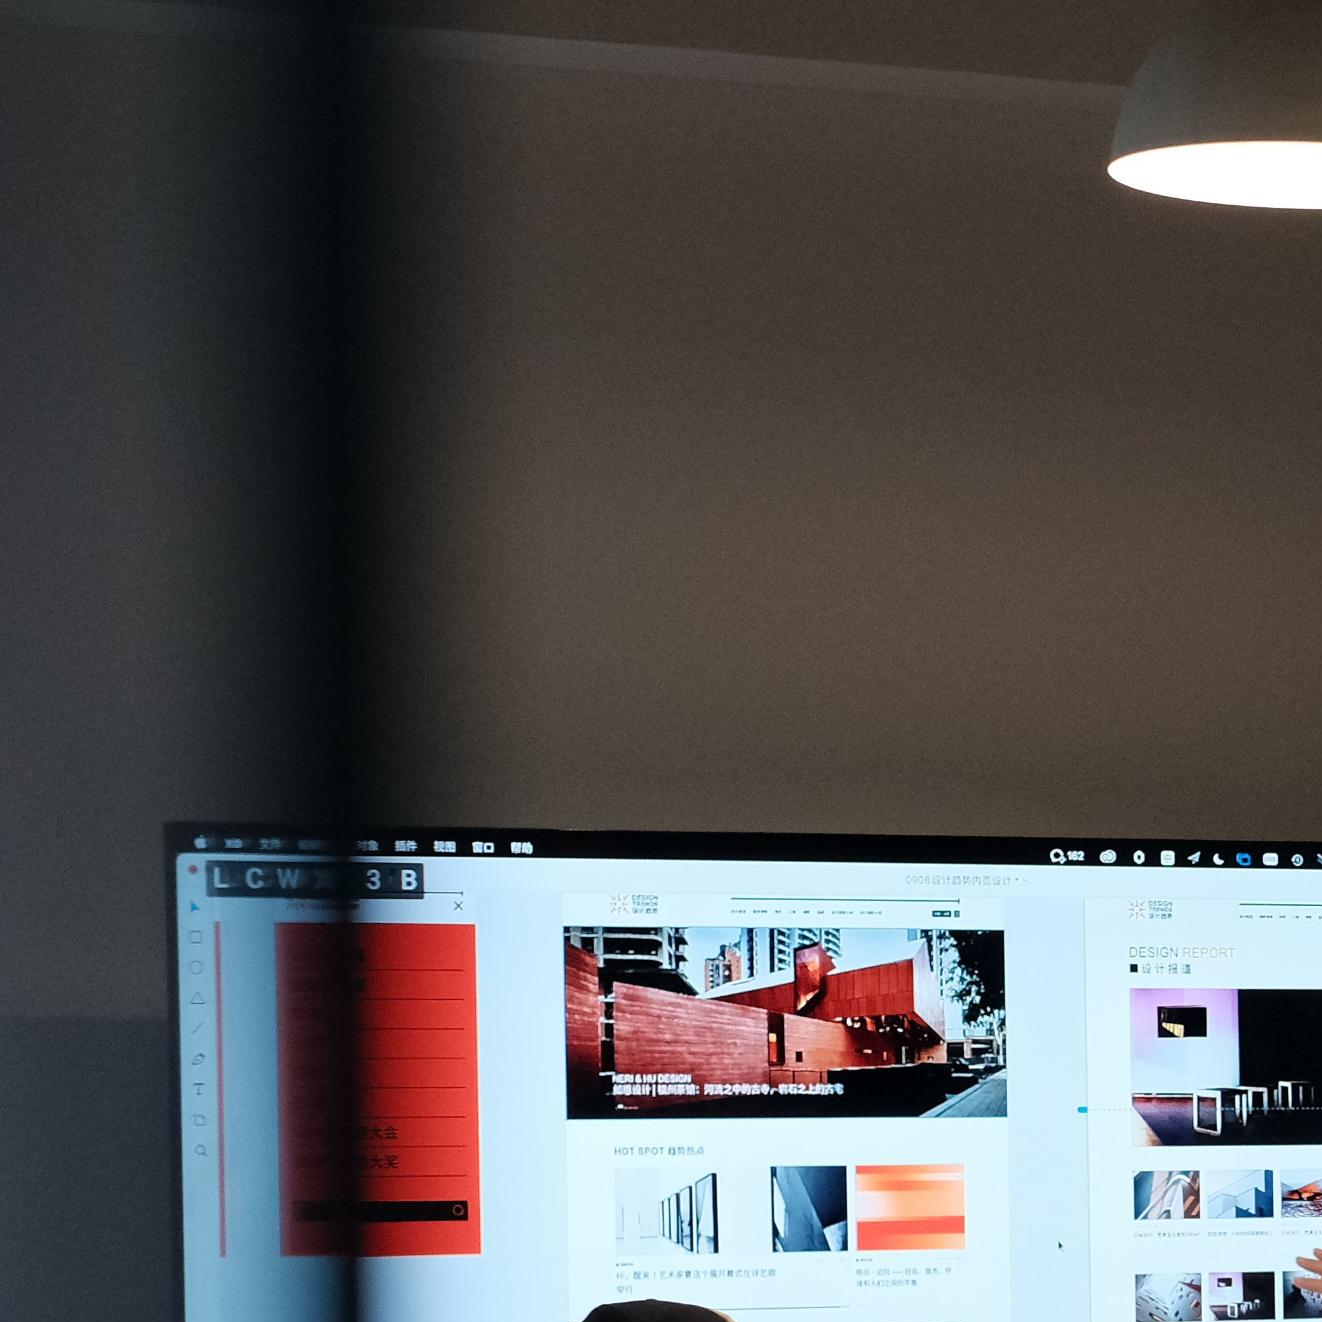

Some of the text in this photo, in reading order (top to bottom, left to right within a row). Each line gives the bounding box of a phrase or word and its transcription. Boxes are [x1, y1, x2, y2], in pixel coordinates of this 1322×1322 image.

[1129, 946, 1236, 958] DESIGN REPORT
[657, 1074, 691, 1083] DESIGN
[614, 1147, 634, 1156] HOT
[637, 1147, 664, 1156] SPOT
